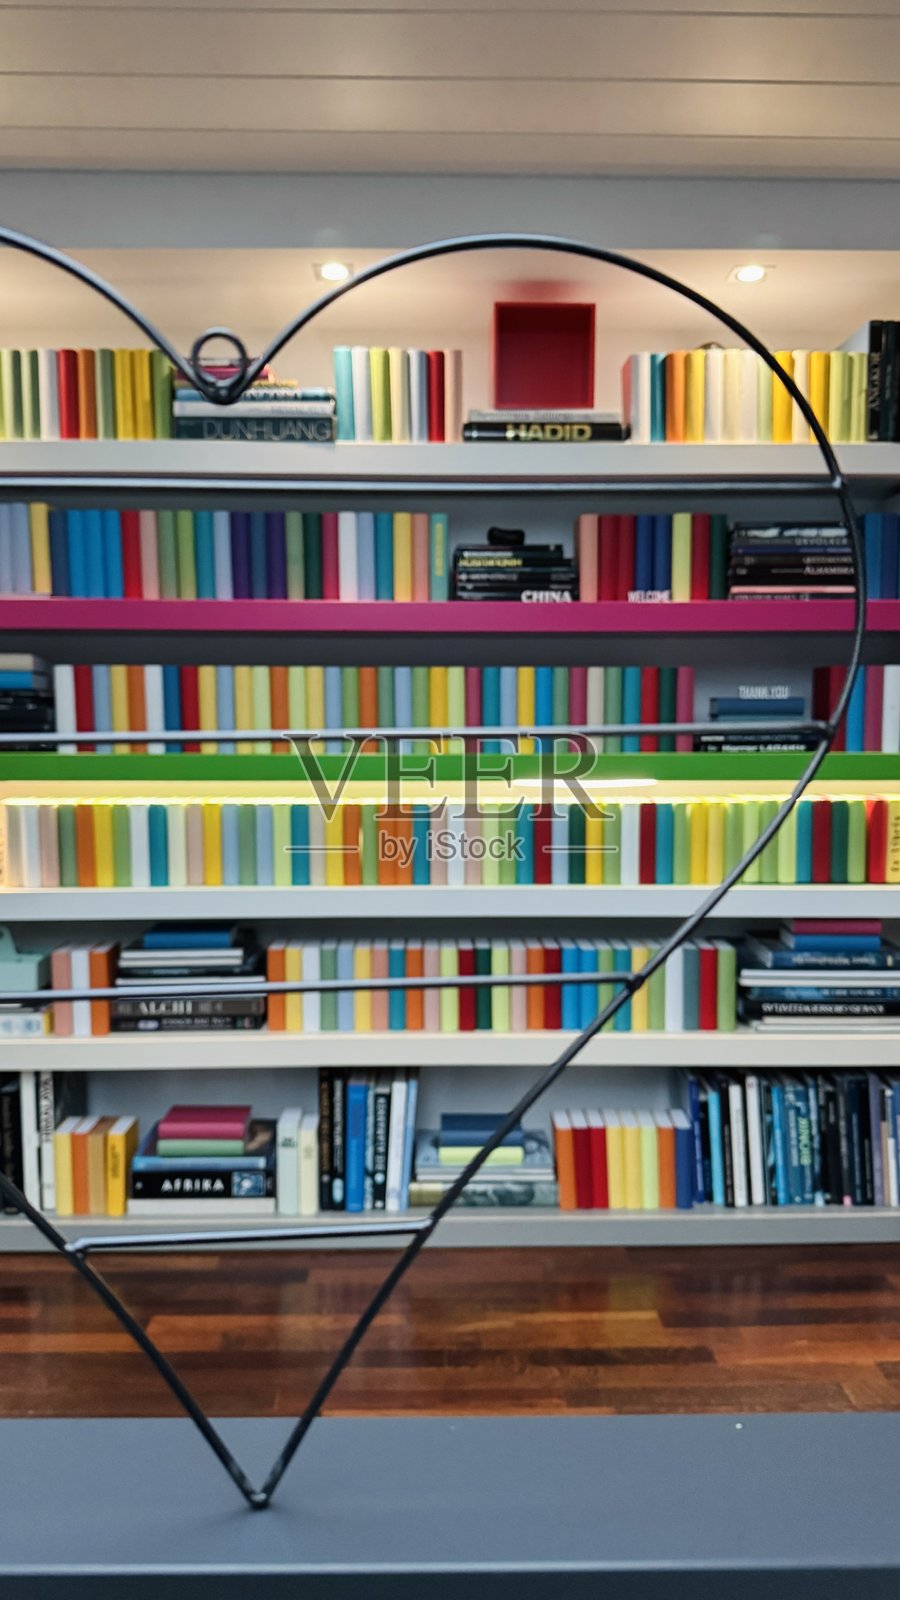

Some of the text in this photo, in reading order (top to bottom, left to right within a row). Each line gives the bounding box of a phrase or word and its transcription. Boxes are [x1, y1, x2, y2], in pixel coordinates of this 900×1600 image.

[202, 419, 331, 441] DUNHUANG
[506, 423, 592, 441] HADID
[521, 590, 573, 603] CHINA
[627, 590, 672, 603] WELCOME
[739, 685, 789, 699] THANK YOU
[161, 1178, 225, 1192] AFRIKA
